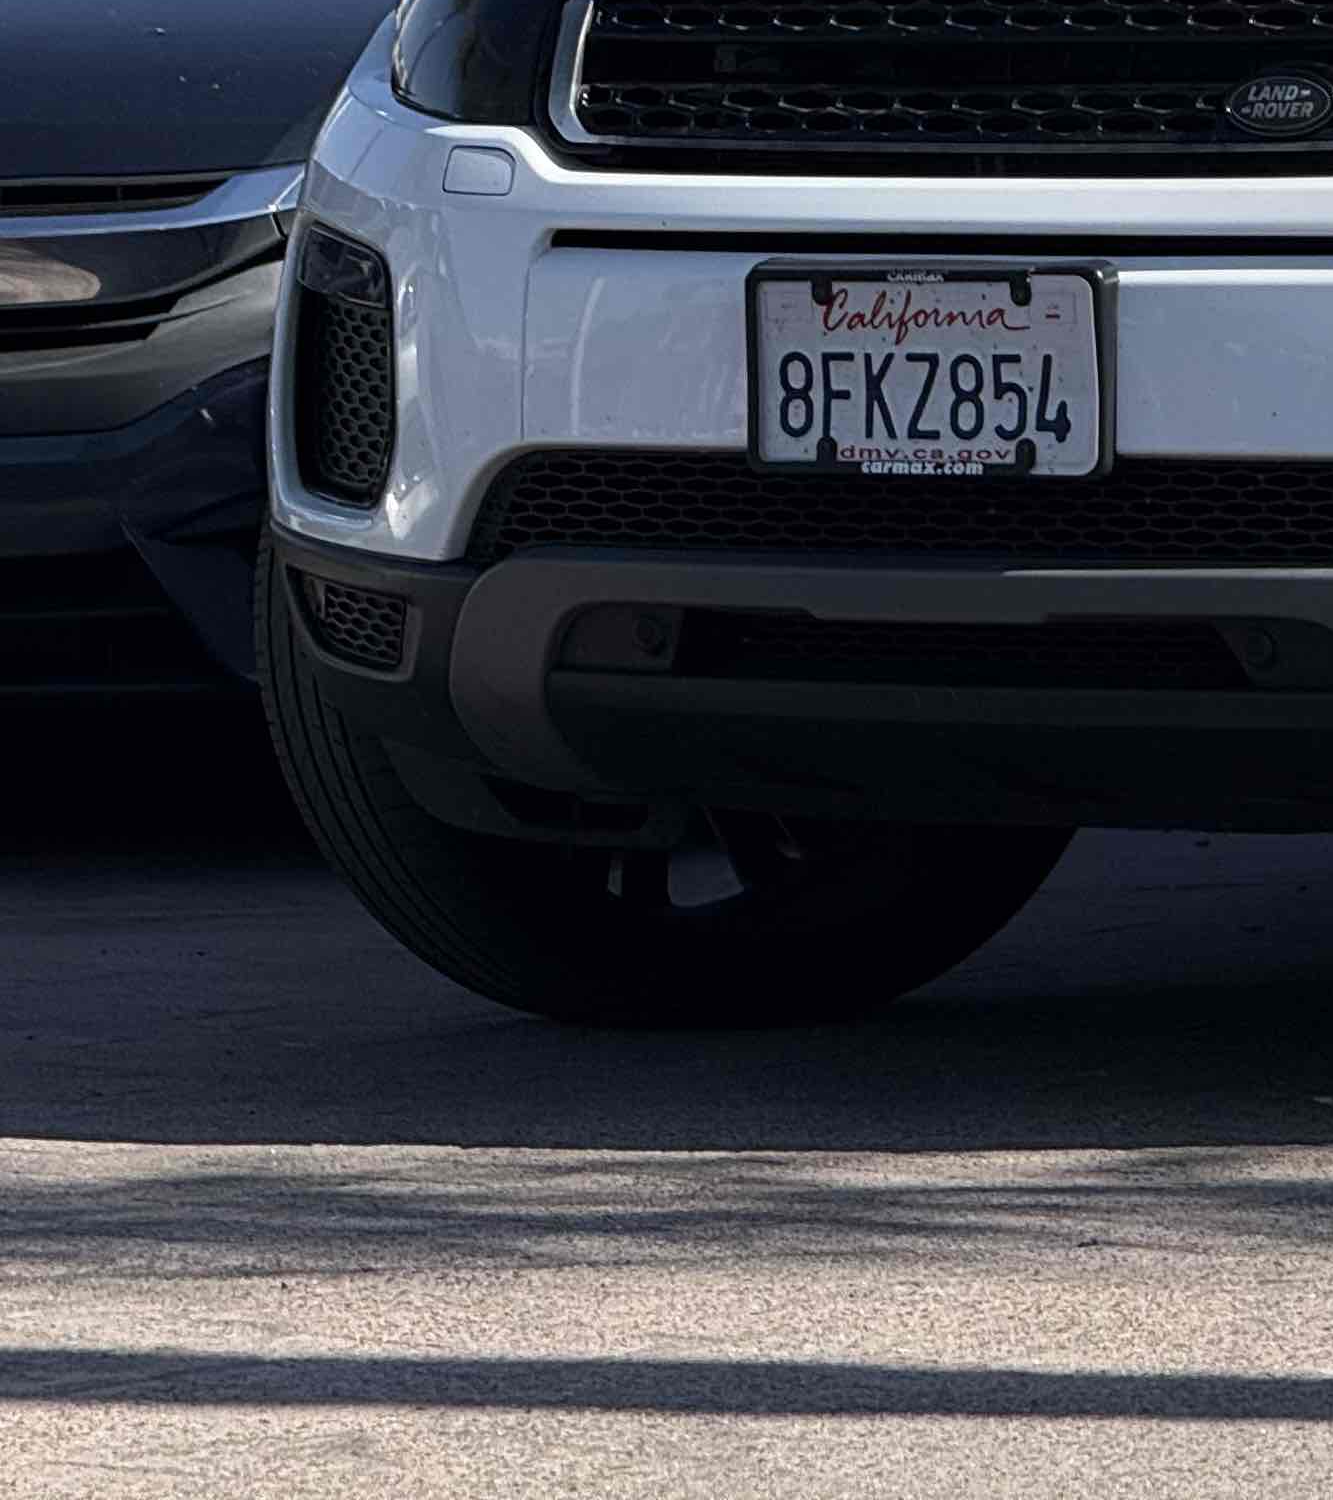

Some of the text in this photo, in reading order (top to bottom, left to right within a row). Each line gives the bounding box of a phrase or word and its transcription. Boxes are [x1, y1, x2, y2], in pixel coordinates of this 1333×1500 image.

[821, 287, 1031, 346] California
[778, 351, 1071, 443] 8FKZ854
[839, 444, 1010, 463] dmv.ca.gov
[861, 459, 984, 475] carmax.com
